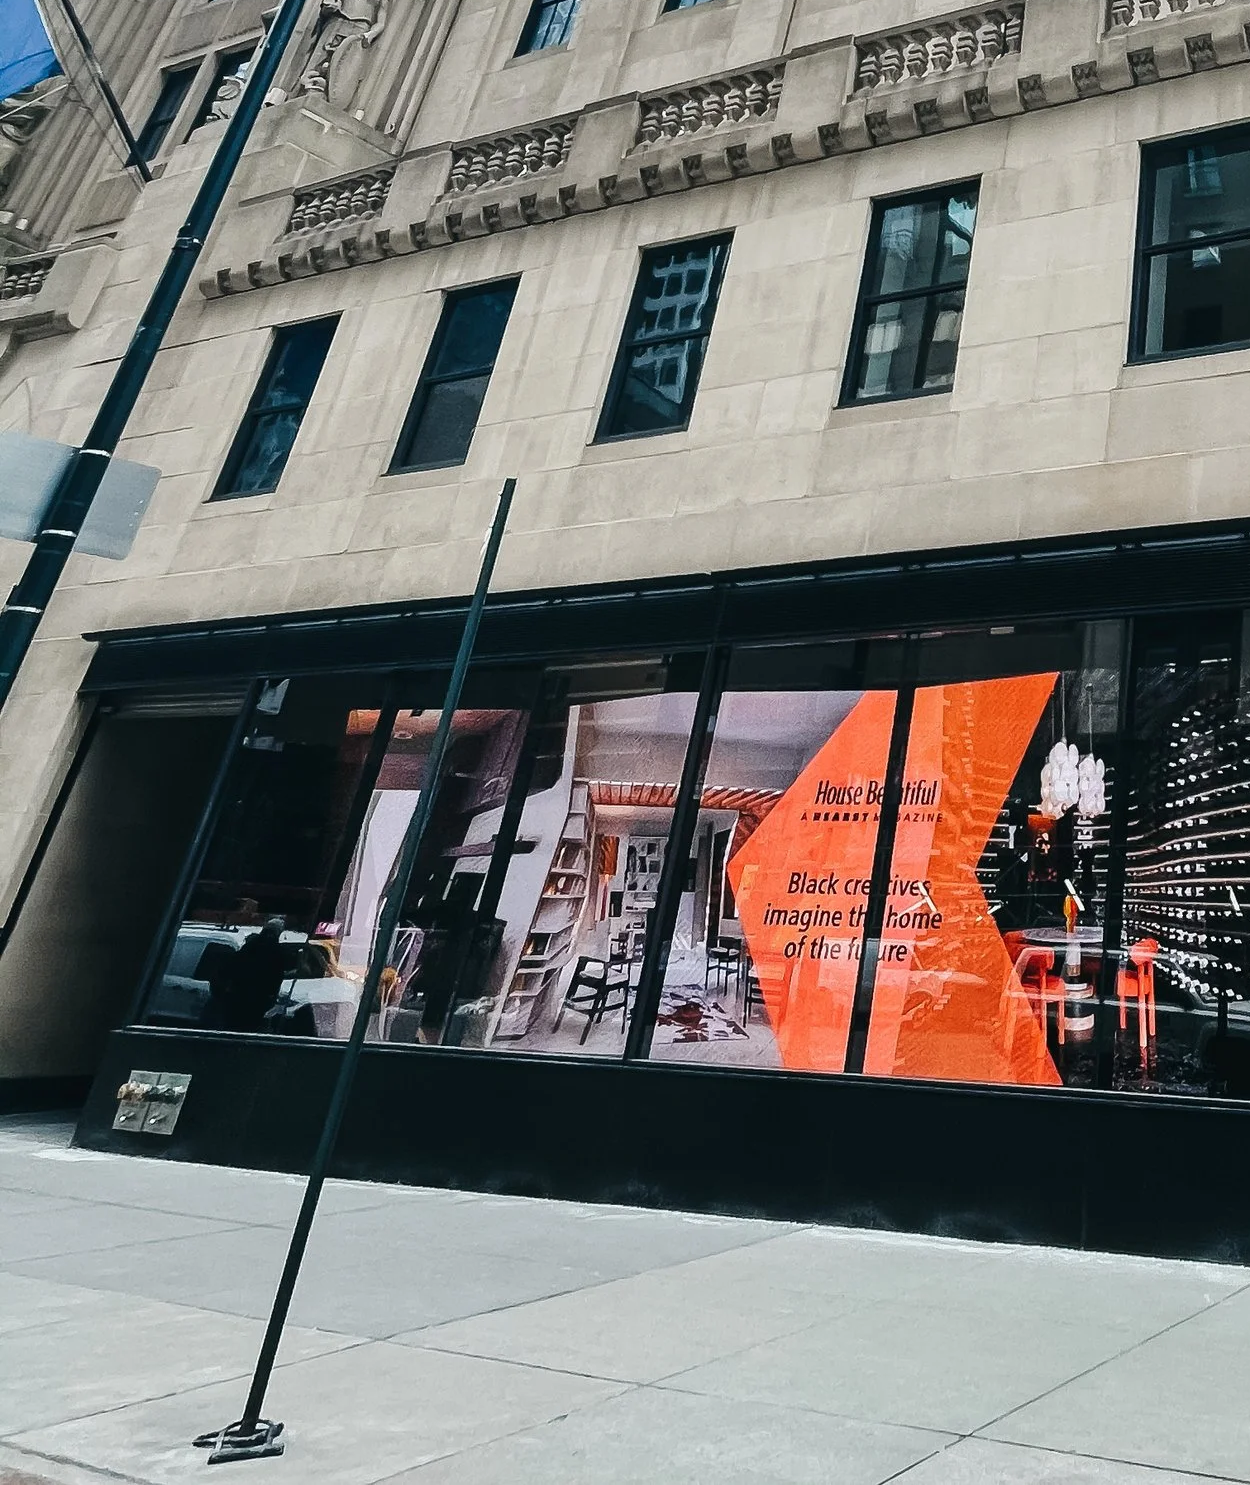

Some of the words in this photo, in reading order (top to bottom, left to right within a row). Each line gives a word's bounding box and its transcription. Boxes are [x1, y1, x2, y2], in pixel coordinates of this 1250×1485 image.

[814, 779, 863, 805] House
[866, 779, 937, 805] Betiful
[801, 812, 808, 821] A
[812, 812, 869, 822] HEARST
[787, 872, 839, 895] Black
[844, 874, 930, 896] creives
[763, 903, 843, 932] imagine
[849, 904, 868, 927] th
[886, 904, 943, 929] home
[784, 935, 807, 958] of
[810, 935, 841, 959] the
[848, 936, 908, 961] fuure
